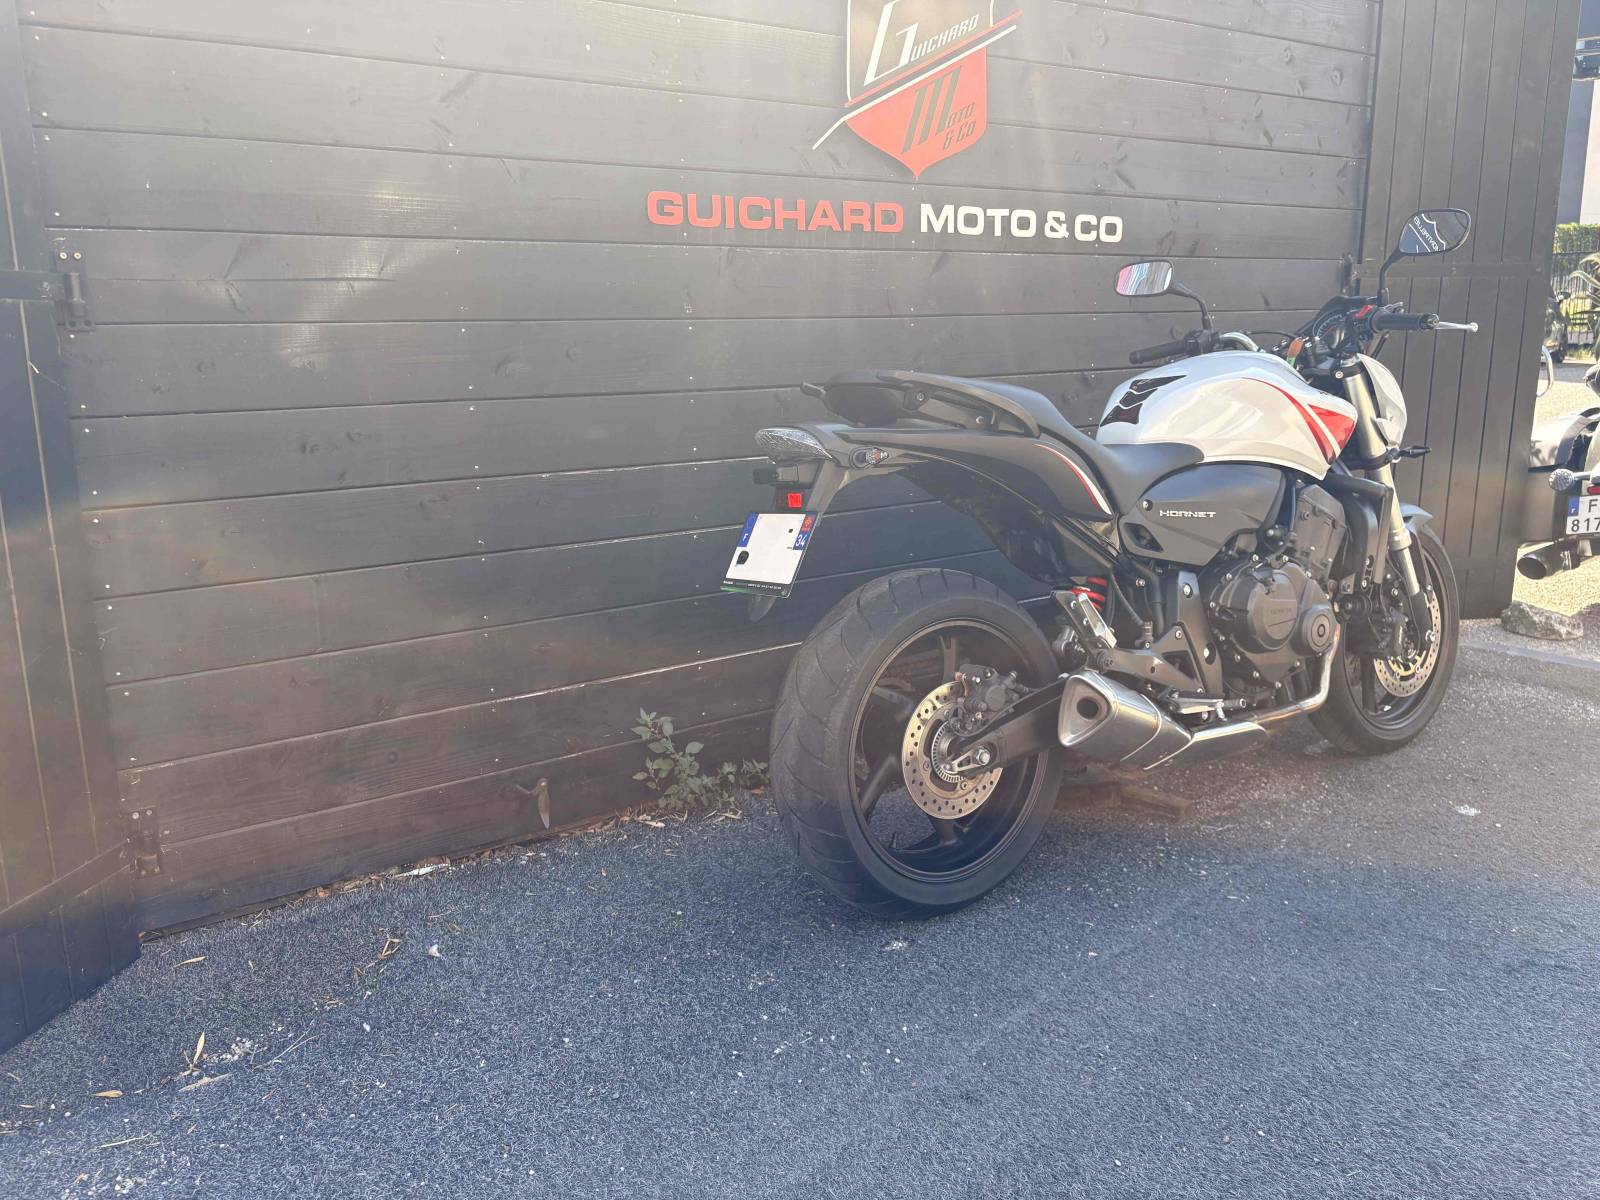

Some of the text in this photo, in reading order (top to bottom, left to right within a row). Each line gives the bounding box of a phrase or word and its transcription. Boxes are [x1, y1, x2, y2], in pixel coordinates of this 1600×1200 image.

[647, 191, 904, 233] GUICHARD
[1159, 510, 1217, 518] HORNET
[795, 534, 807, 547] 34
